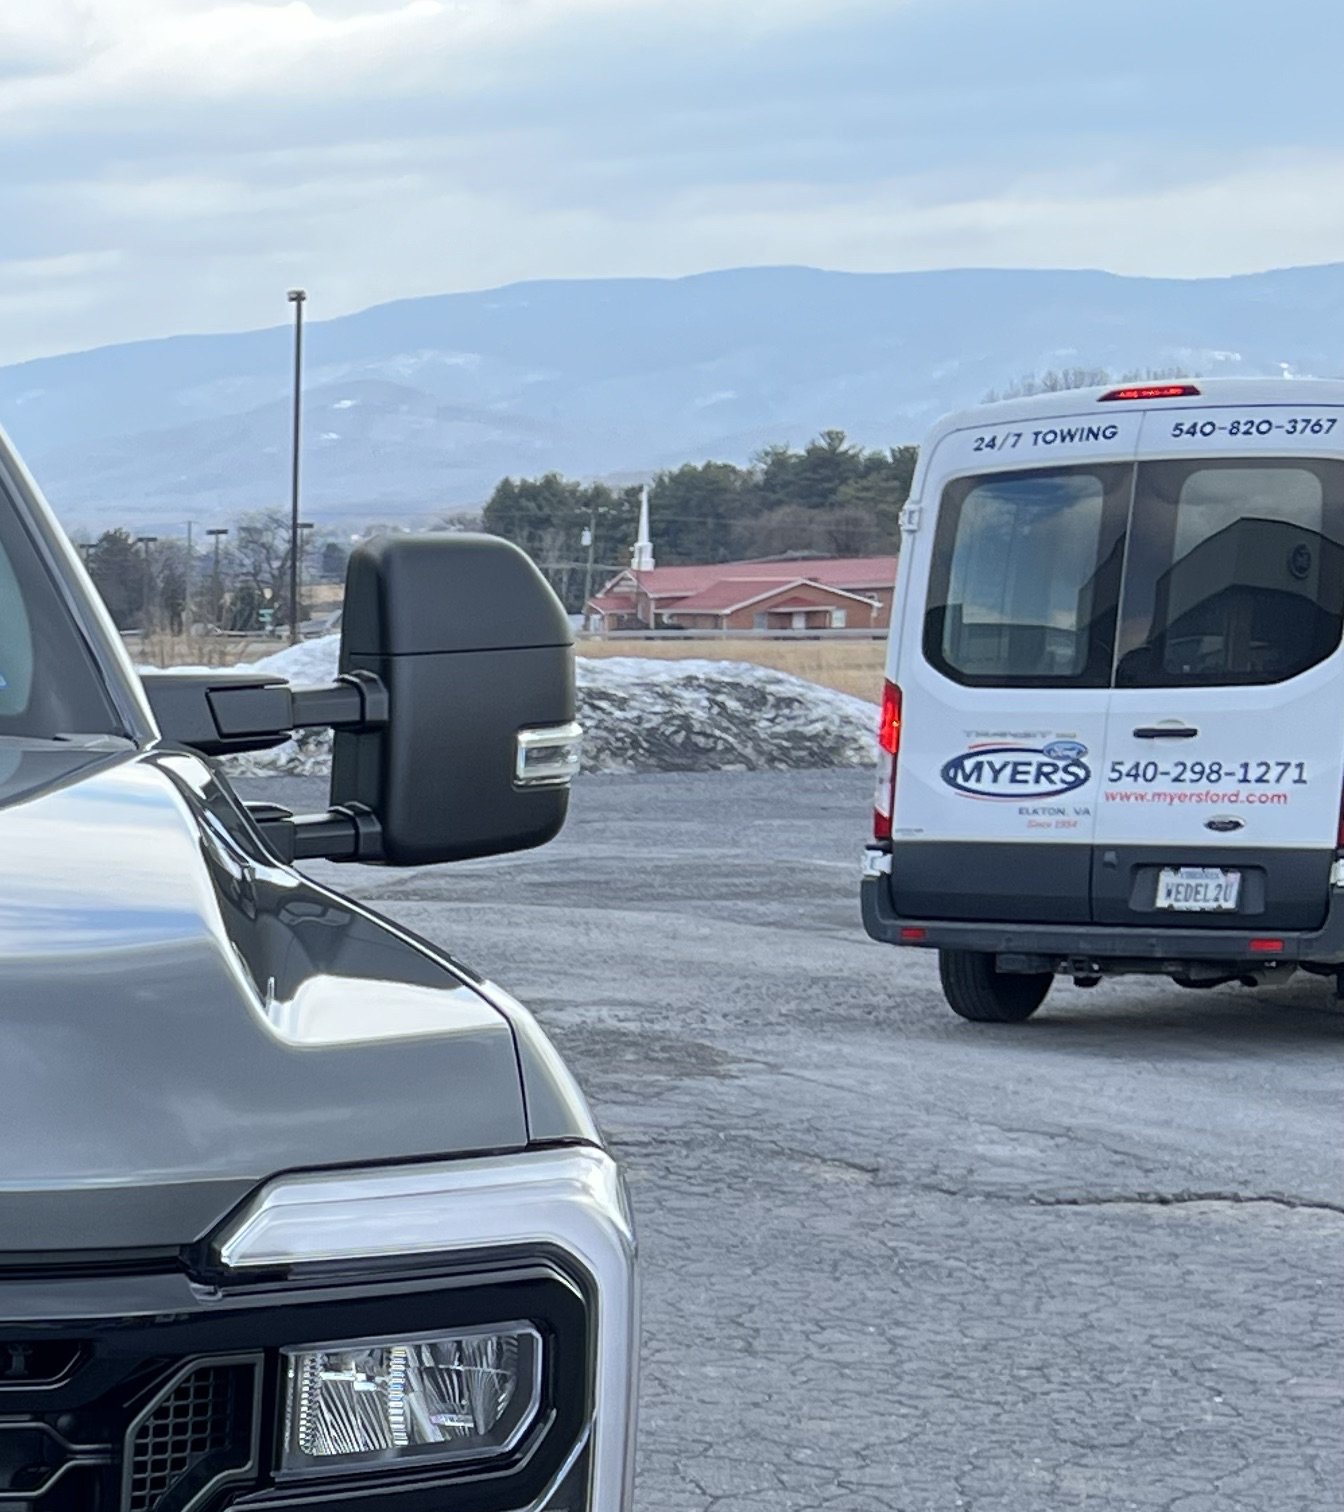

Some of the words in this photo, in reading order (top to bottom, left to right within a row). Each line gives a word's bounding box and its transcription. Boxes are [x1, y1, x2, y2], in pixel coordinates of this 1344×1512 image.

[973, 432, 1023, 452] 24/7
[1032, 425, 1119, 446] TOWING
[1171, 418, 1338, 438] 540-820-3767
[952, 759, 1084, 786] MYERS
[1108, 761, 1308, 785] 540-298-1271
[1104, 790, 1288, 806] www.myersford.com
[1164, 882, 1234, 902] WEDEL2U
